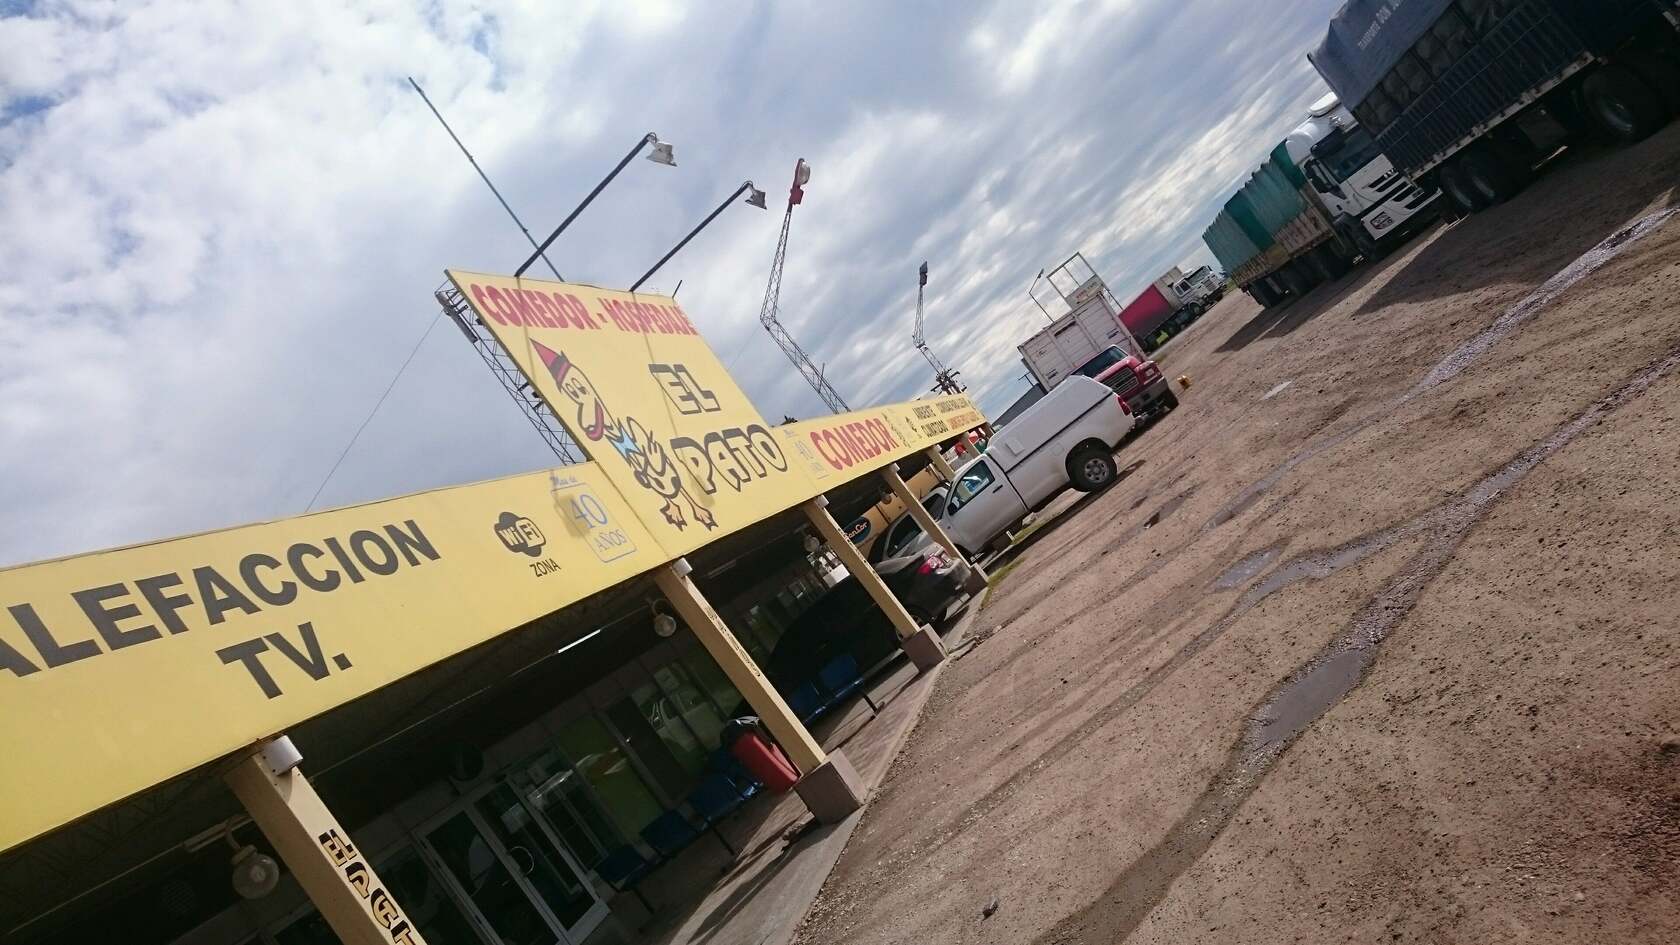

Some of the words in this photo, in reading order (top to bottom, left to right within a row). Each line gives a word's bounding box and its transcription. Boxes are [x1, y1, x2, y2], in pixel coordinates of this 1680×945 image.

[470, 283, 601, 329] COMEDOR
[648, 364, 721, 415] EL
[670, 424, 787, 495] PATO
[810, 417, 899, 470] COMEDOR
[570, 494, 608, 528] 40
[530, 558, 561, 577] ZONA
[216, 621, 353, 699] TV.
[318, 829, 357, 867] EL
